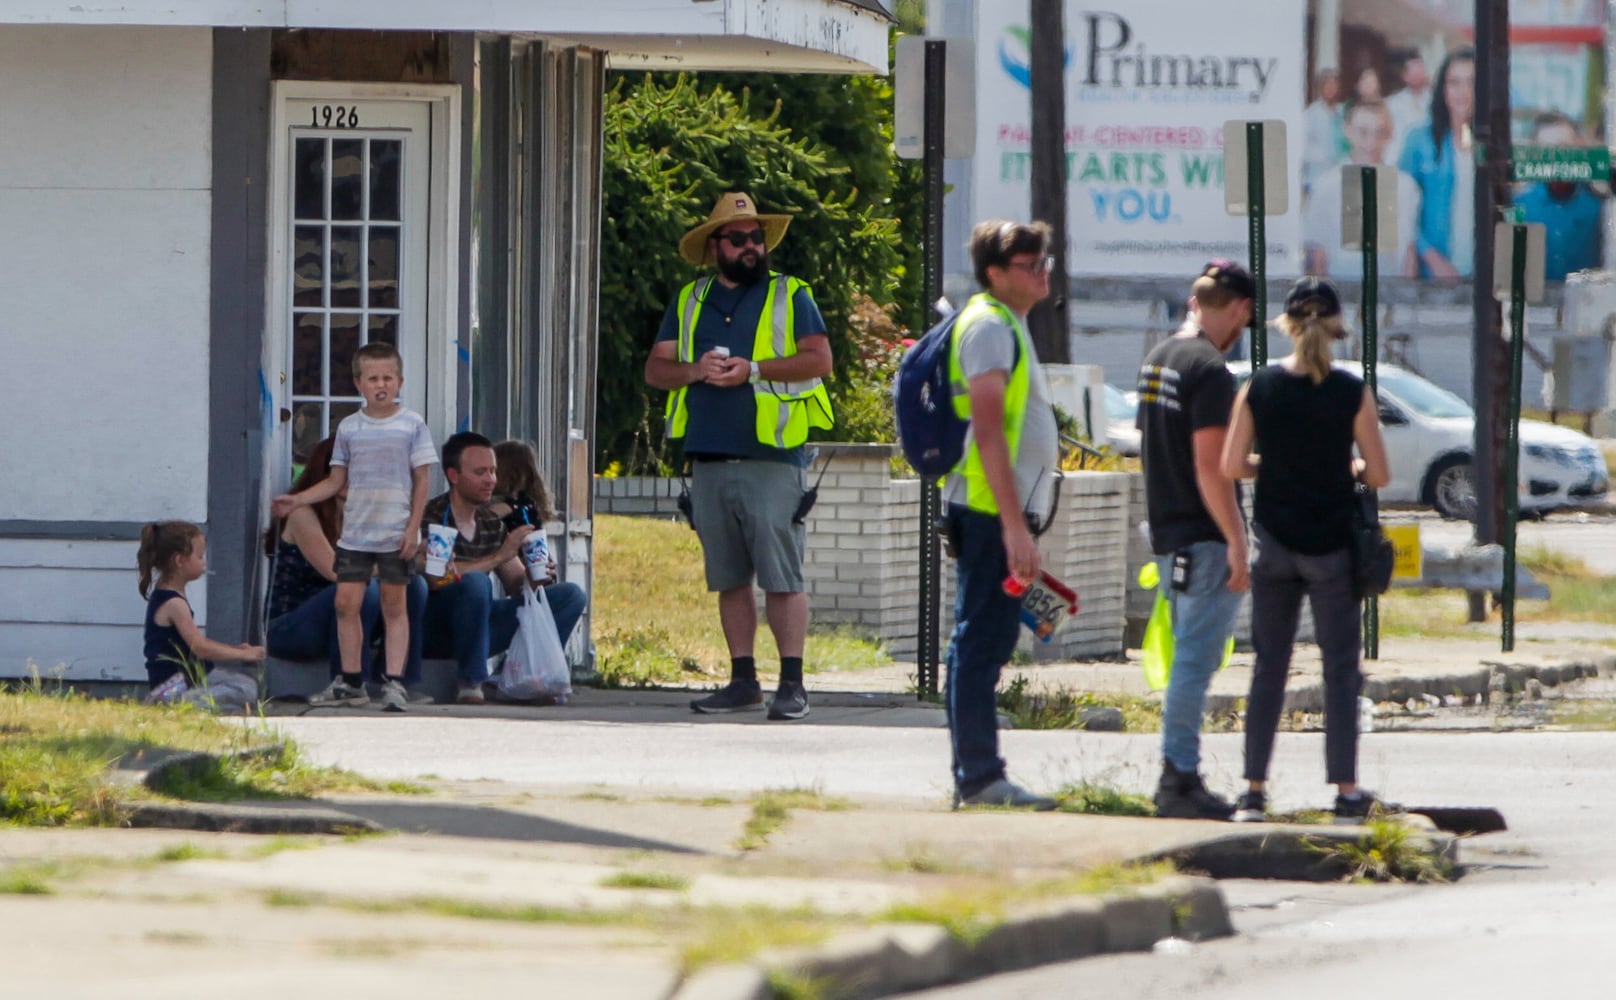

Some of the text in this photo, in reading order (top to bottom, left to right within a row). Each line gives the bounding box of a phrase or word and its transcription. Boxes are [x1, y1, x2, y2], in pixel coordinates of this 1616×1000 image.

[1079, 11, 1277, 103] Primary
[311, 105, 359, 128] 1926
[1065, 152, 1168, 186] TARTS
[1181, 152, 1225, 187] WI
[1515, 161, 1593, 180] CRAWFORD
